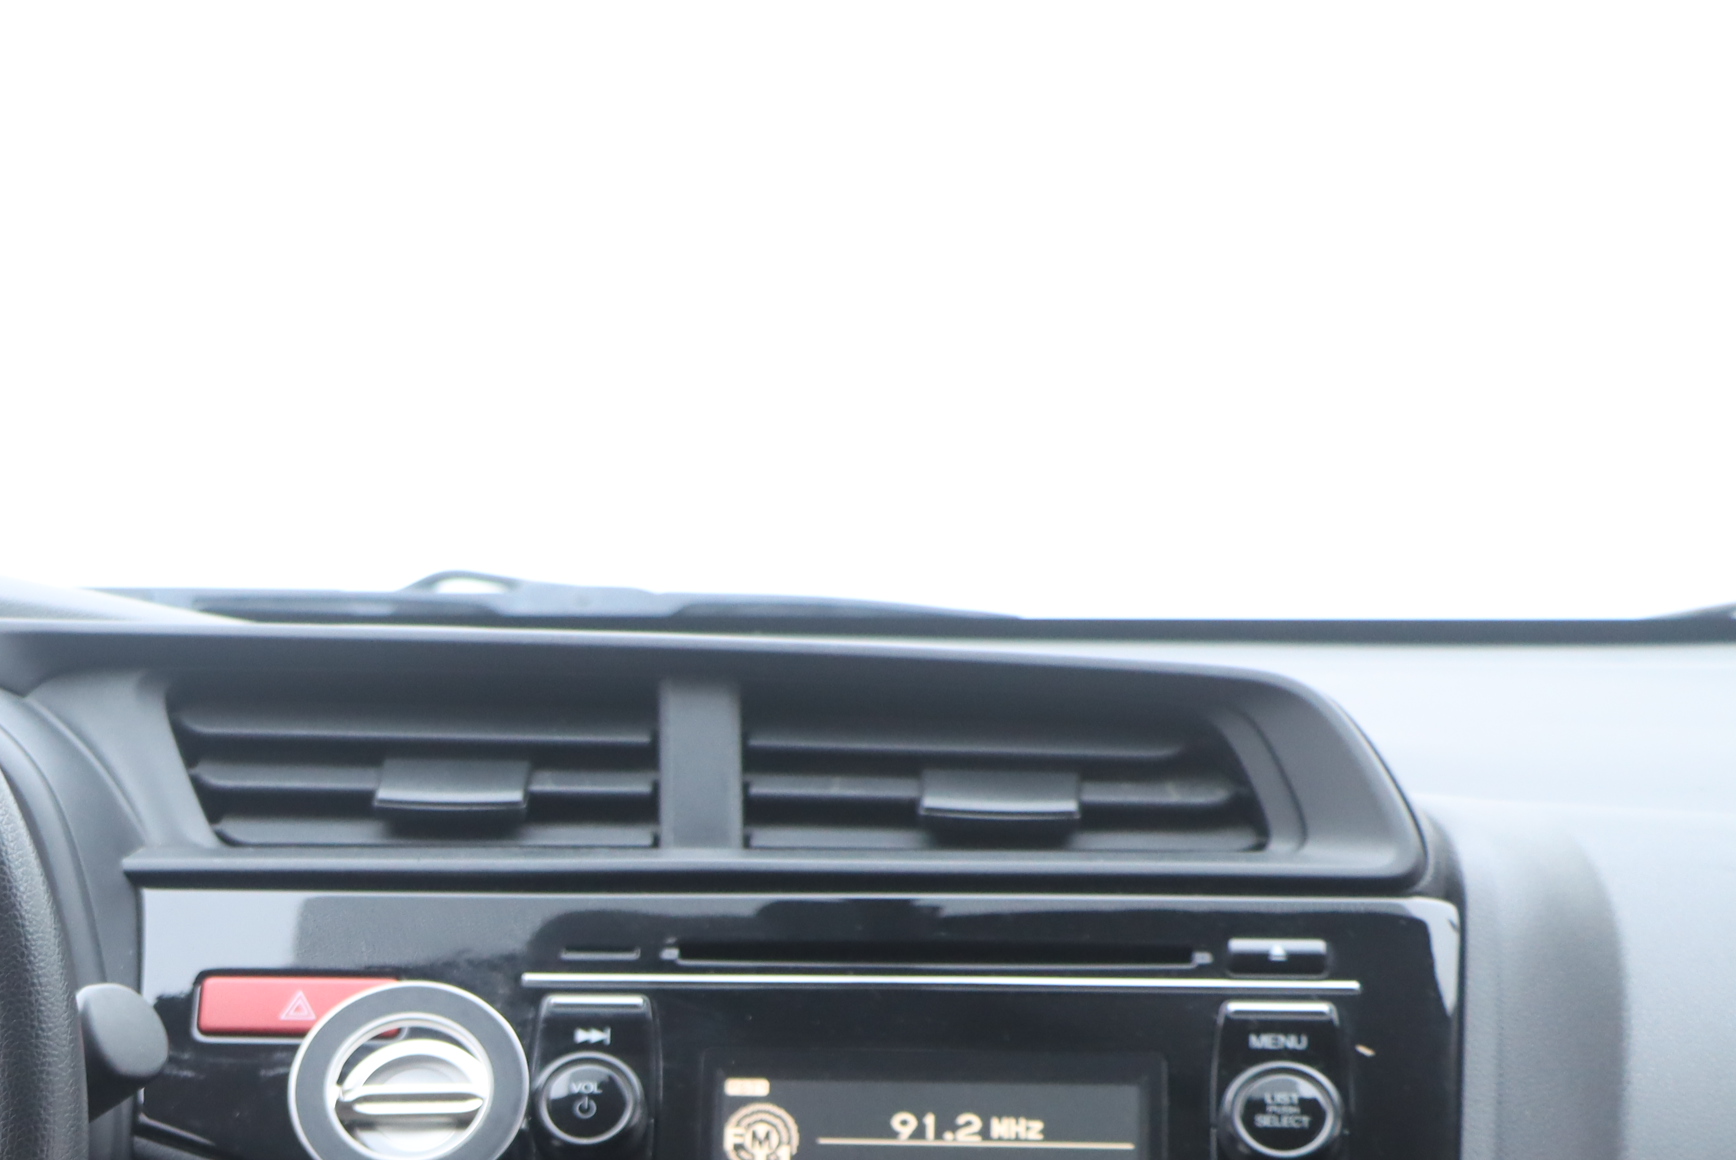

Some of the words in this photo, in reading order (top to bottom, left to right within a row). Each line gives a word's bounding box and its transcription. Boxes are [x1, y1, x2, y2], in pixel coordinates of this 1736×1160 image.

[1248, 1033, 1308, 1050] MENU
[570, 1081, 603, 1095] VOL
[890, 1111, 983, 1142] 91.2
[989, 1115, 1045, 1141] MHz
